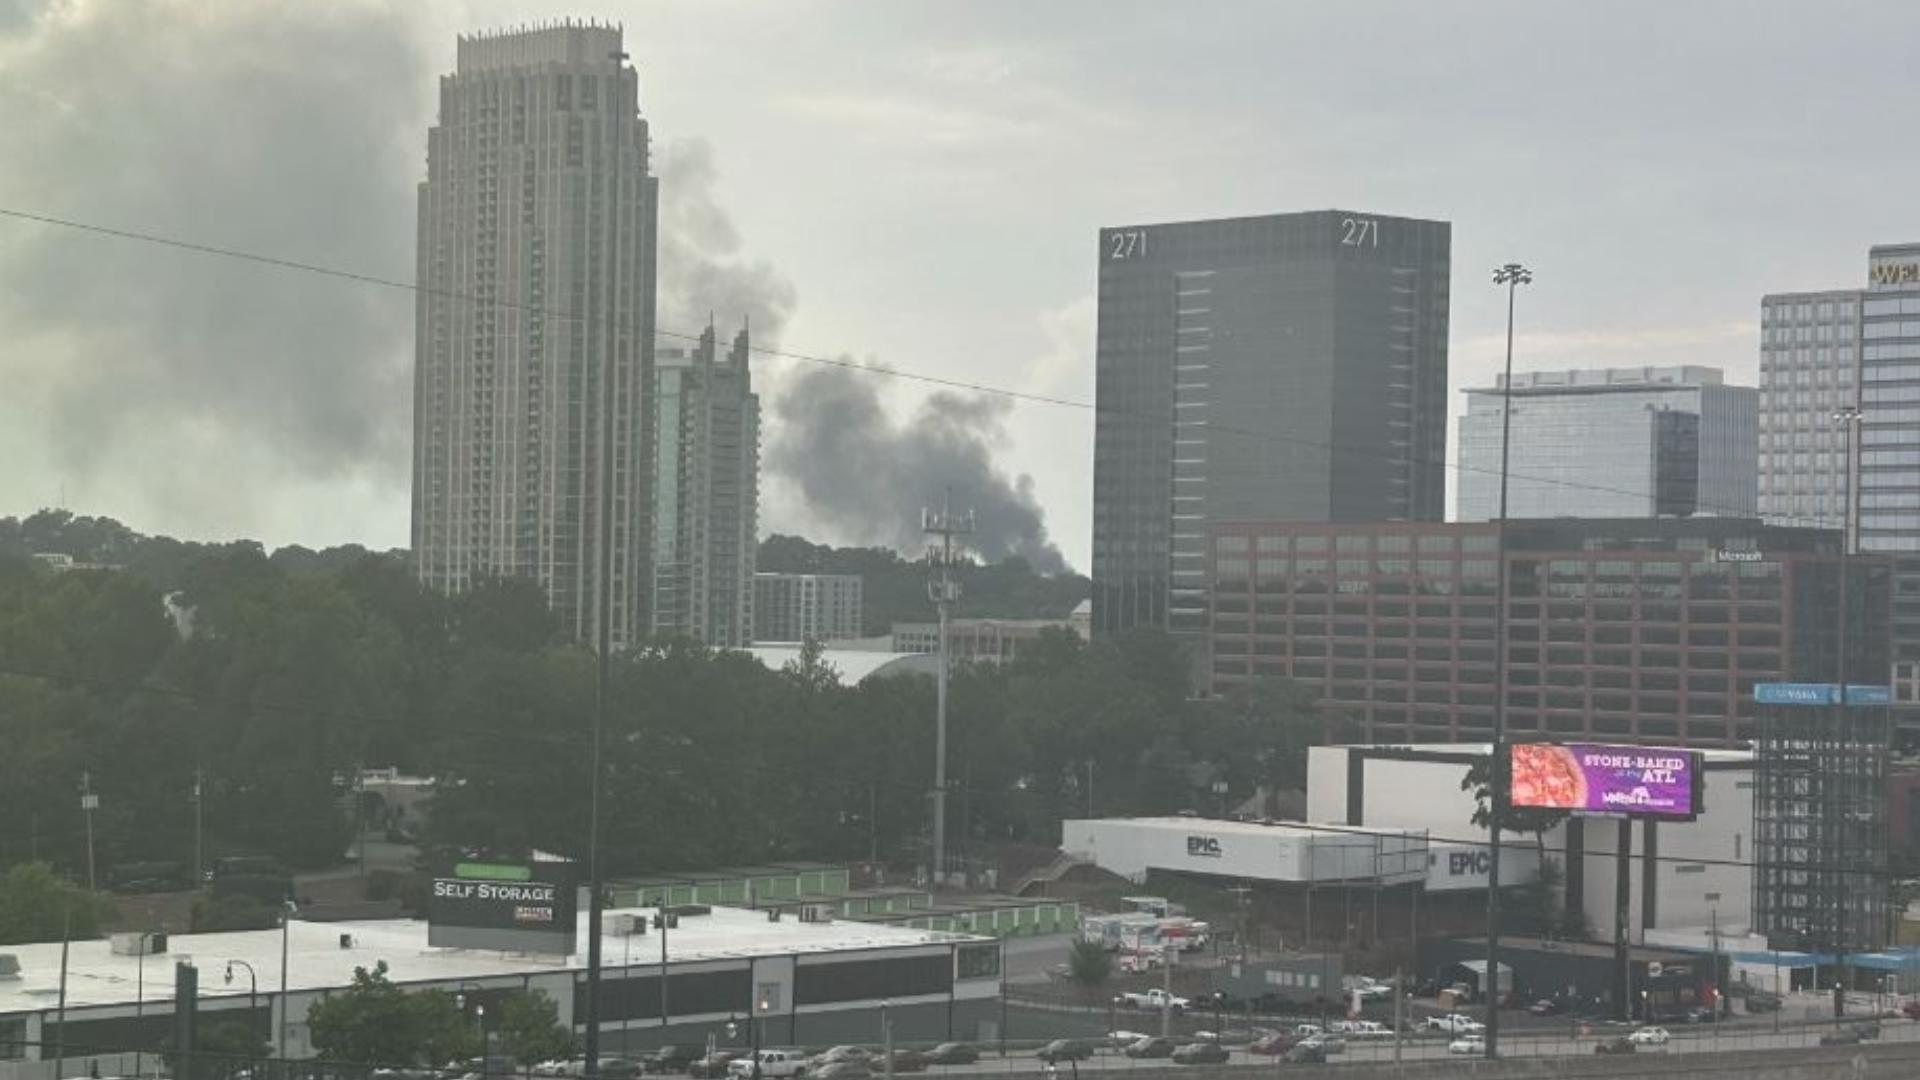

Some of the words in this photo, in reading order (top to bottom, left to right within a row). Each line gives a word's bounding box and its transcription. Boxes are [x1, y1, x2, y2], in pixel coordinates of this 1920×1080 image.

[1341, 218, 1378, 248] 271
[1111, 231, 1147, 258] 271
[1584, 754, 1685, 771] STONE-BAKED
[1641, 768, 1676, 783] ATL
[433, 881, 475, 898] SELF
[478, 884, 555, 900] STORAGE
